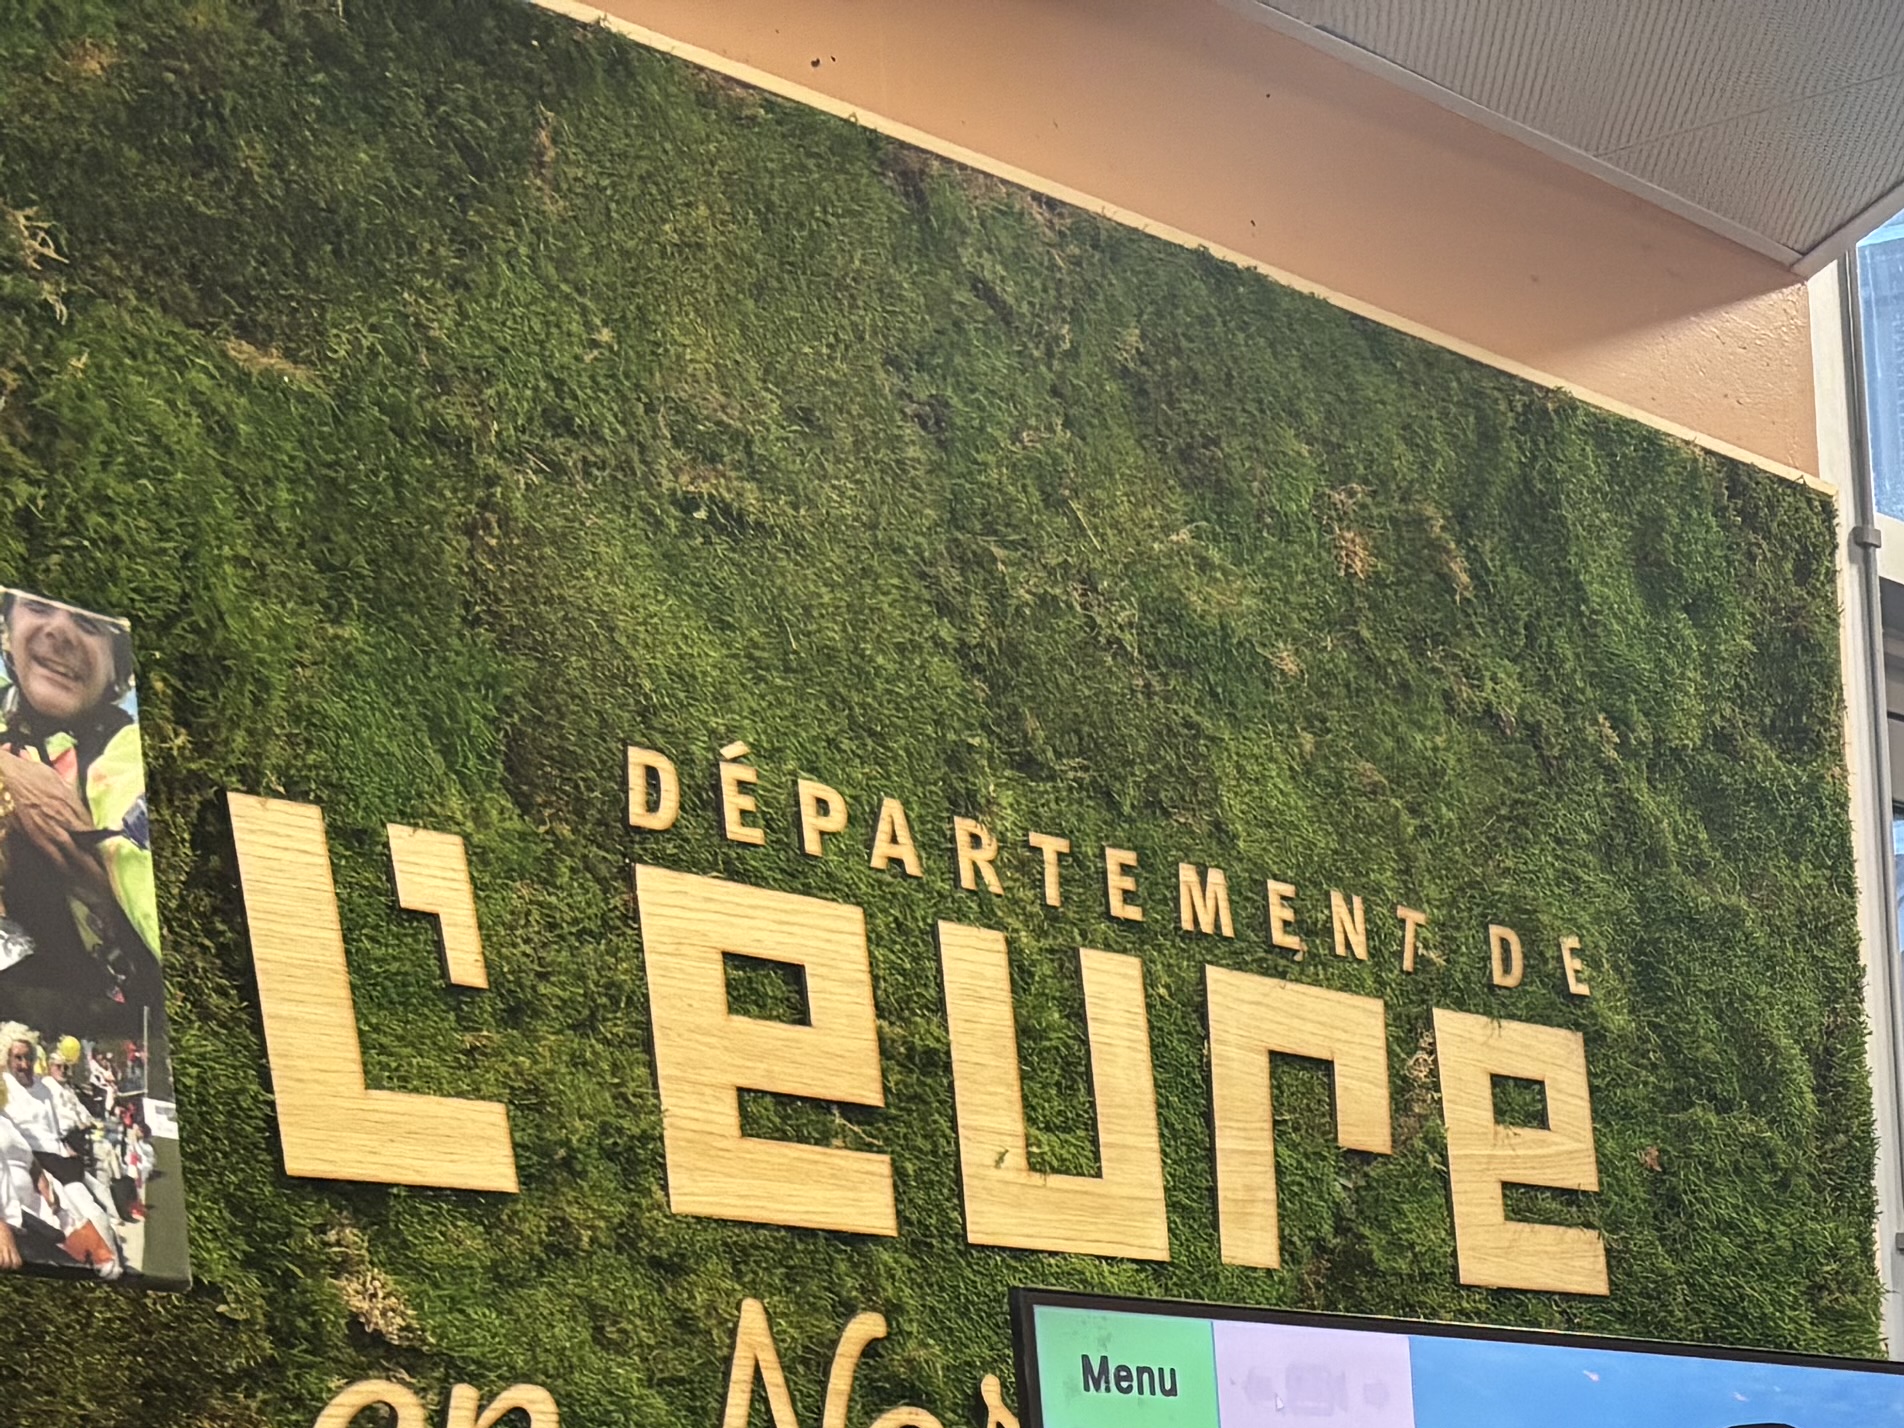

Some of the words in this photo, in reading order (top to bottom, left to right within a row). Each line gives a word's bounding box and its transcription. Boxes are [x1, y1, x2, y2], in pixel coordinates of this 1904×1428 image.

[627, 741, 1427, 972] DÉPARTEMENT
[1487, 923, 1592, 998] DE
[1080, 1353, 1179, 1398] Menu
